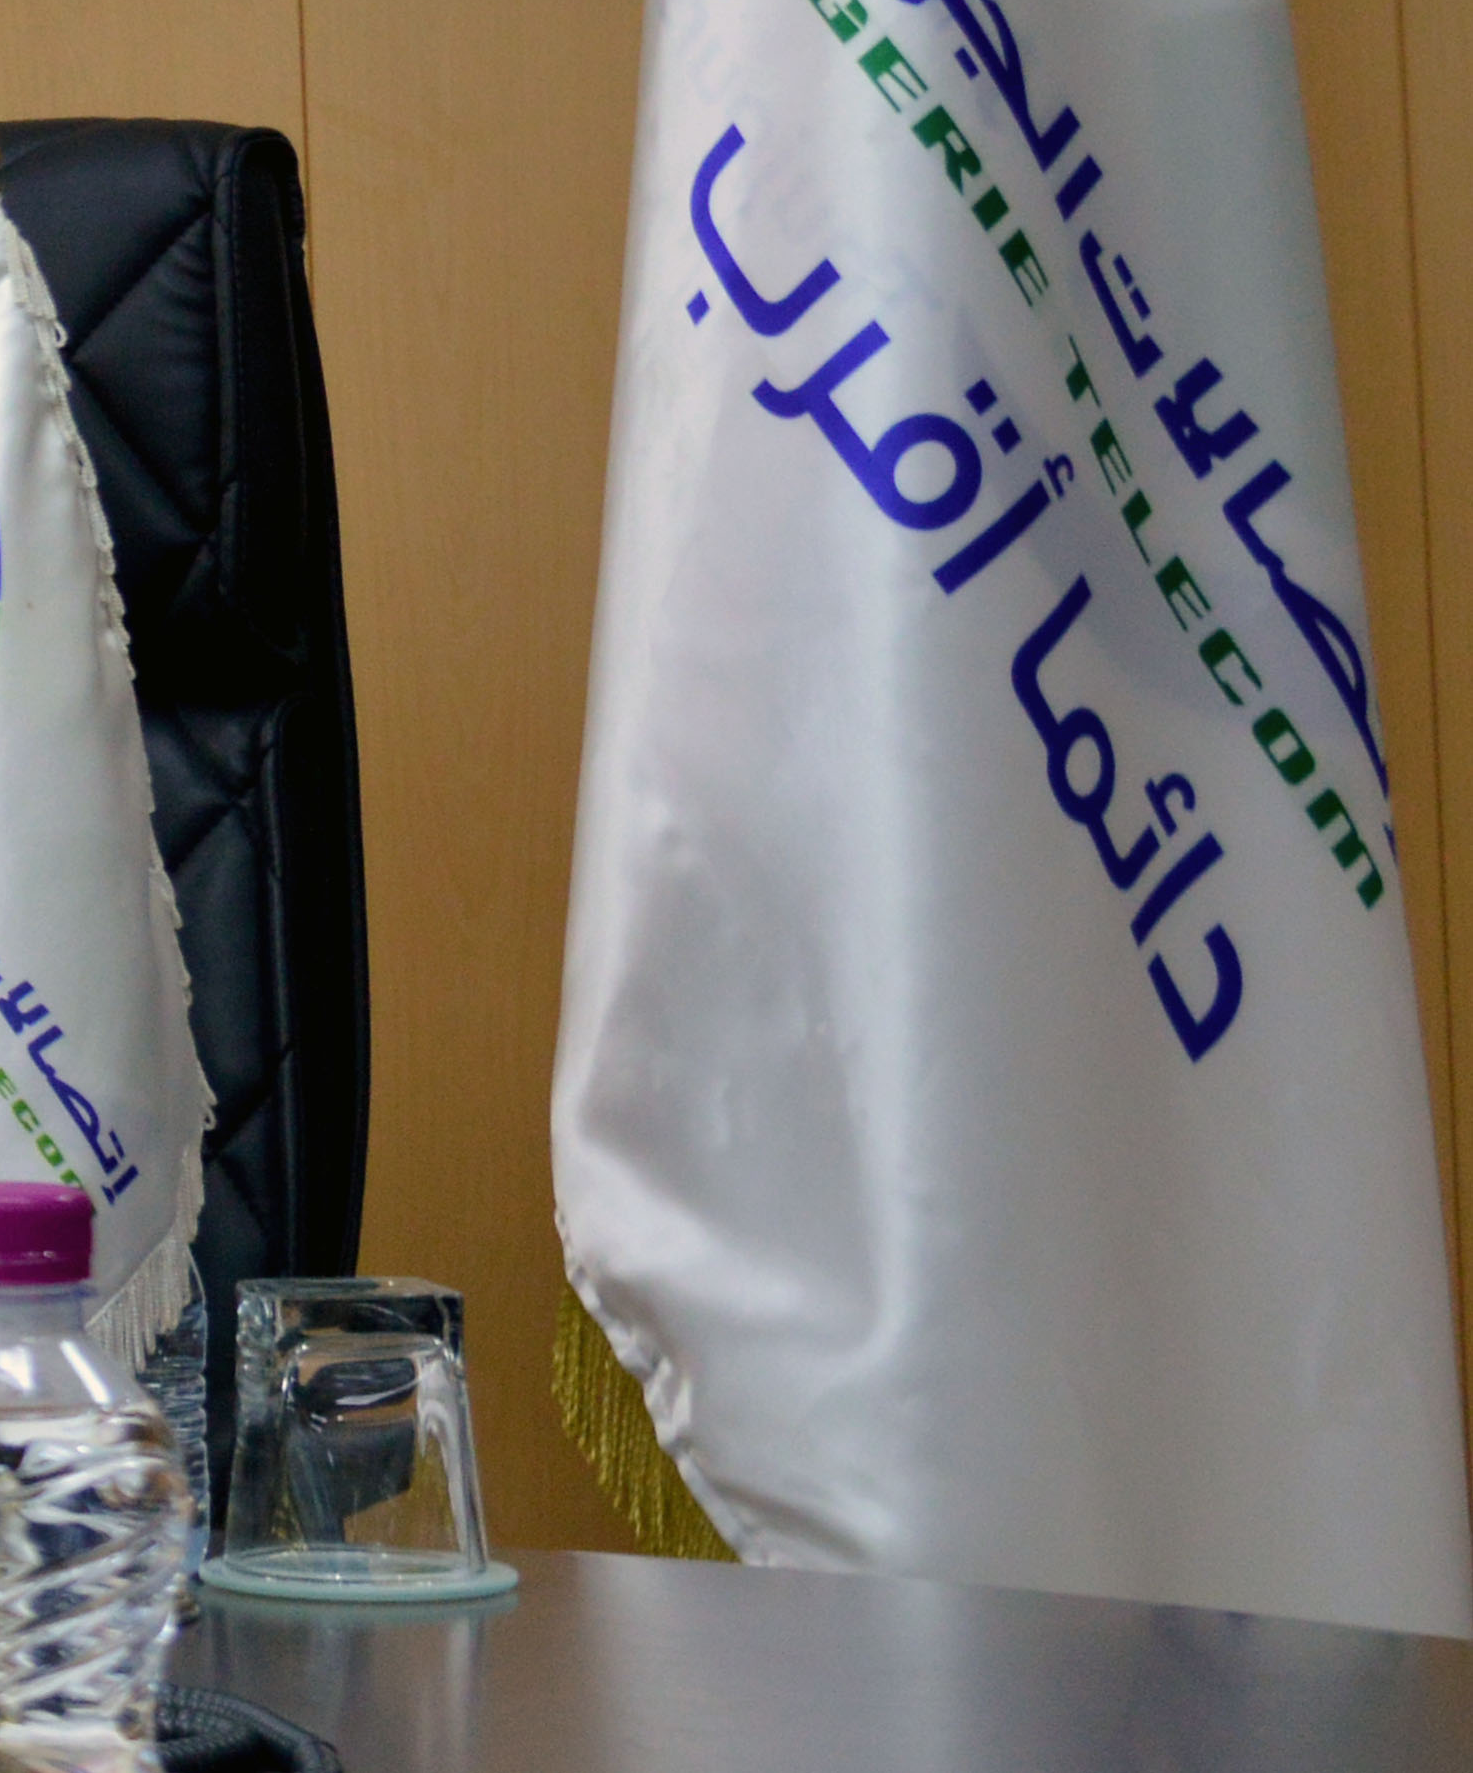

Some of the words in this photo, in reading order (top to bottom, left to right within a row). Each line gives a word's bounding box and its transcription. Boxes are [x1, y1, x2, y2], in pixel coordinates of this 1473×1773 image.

[684, 121, 1076, 597] أقرب
[1010, 572, 1245, 1065] دائما
[1062, 332, 1385, 912] TELECOM
